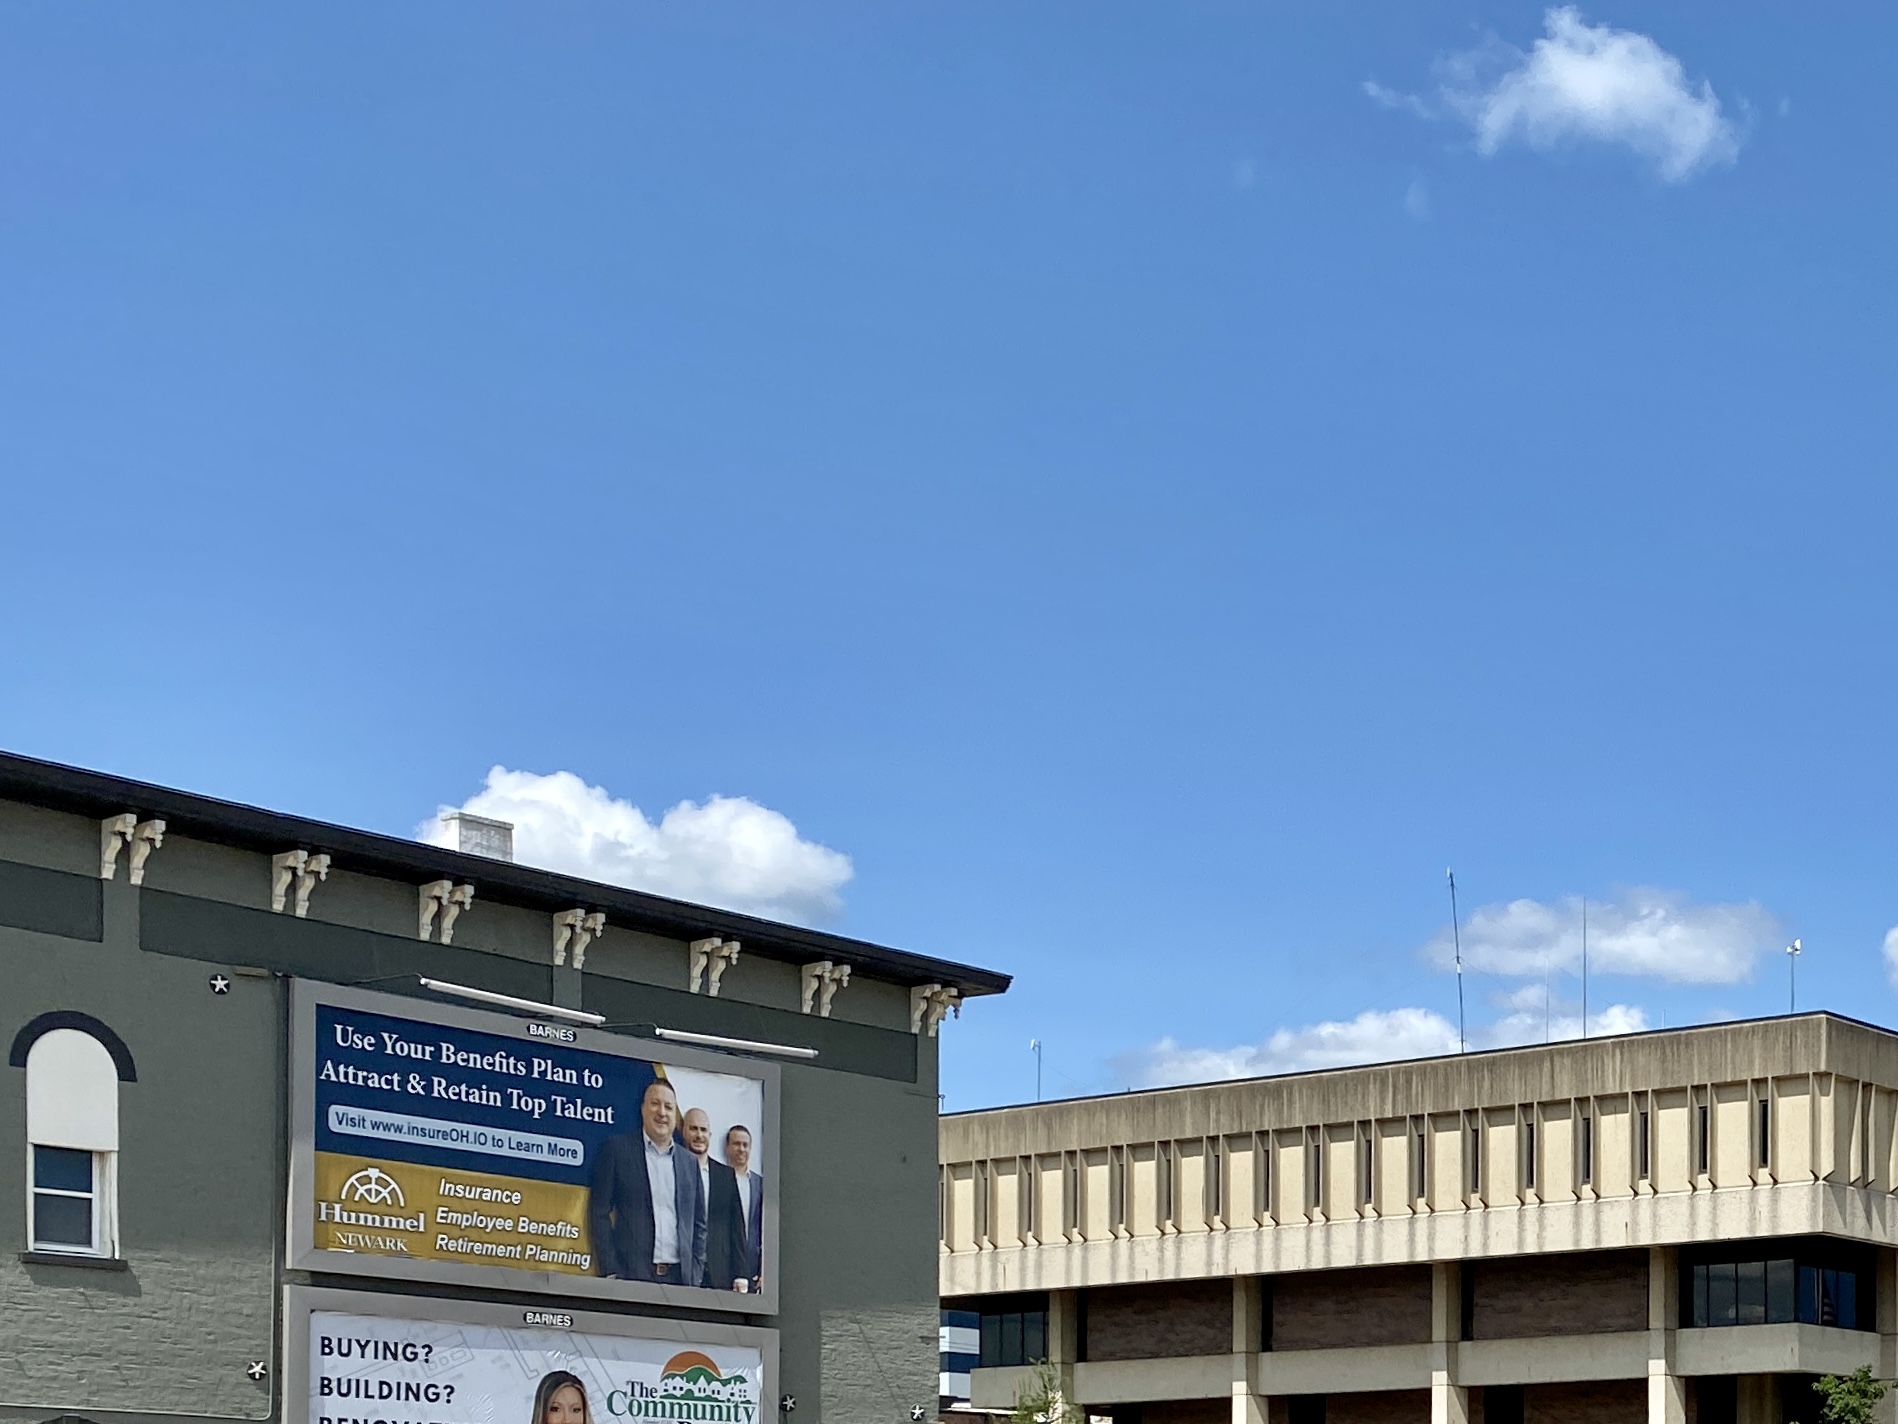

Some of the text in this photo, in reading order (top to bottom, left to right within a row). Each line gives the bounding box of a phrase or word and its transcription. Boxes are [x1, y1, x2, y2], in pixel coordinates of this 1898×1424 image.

[529, 1024, 575, 1042] BARNES
[334, 1024, 603, 1088] Use Your Benefits Plan to
[319, 1060, 615, 1125] Attract & Retain Top Talent
[335, 1111, 578, 1159] Visit www.insureOH.IO to Learn More
[439, 1178, 521, 1205] Insurance
[318, 1202, 425, 1233] Hummel
[436, 1207, 580, 1239] Employee Benefits
[335, 1231, 408, 1252] NEWARK
[435, 1234, 592, 1271] Retirement Planning
[525, 1311, 572, 1328] BARNES
[320, 1336, 433, 1364] BUYING?
[319, 1376, 455, 1404] BUILDING?
[626, 1380, 658, 1399] The
